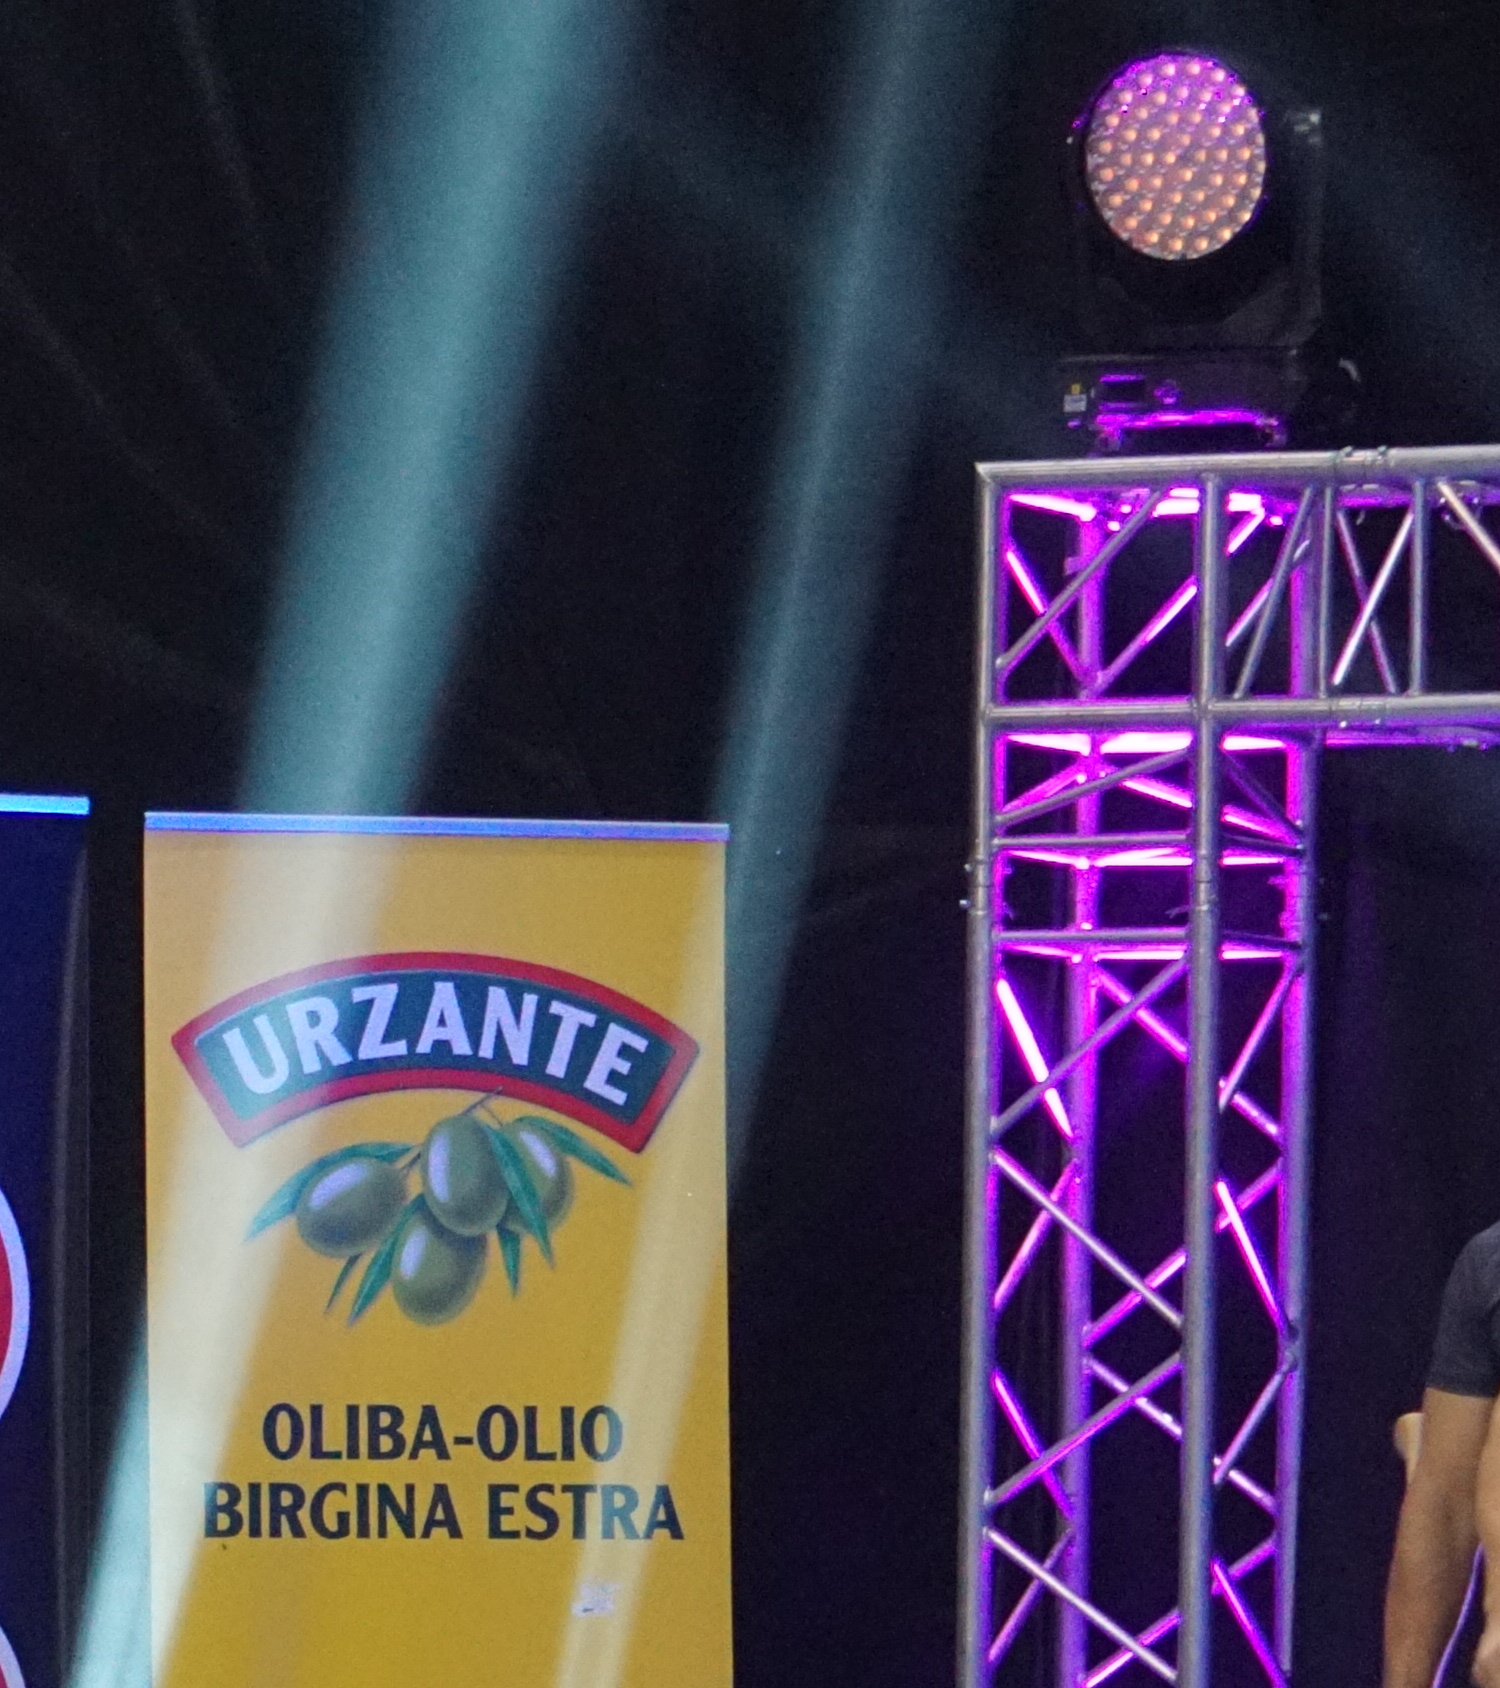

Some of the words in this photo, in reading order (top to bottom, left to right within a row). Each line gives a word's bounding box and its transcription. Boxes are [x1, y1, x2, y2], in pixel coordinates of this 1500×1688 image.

[222, 980, 650, 1107] URZANTE
[262, 1402, 624, 1462] OLIBA-OLIO
[203, 1481, 463, 1540] BIRGINA
[487, 1482, 685, 1542] ESTRA
